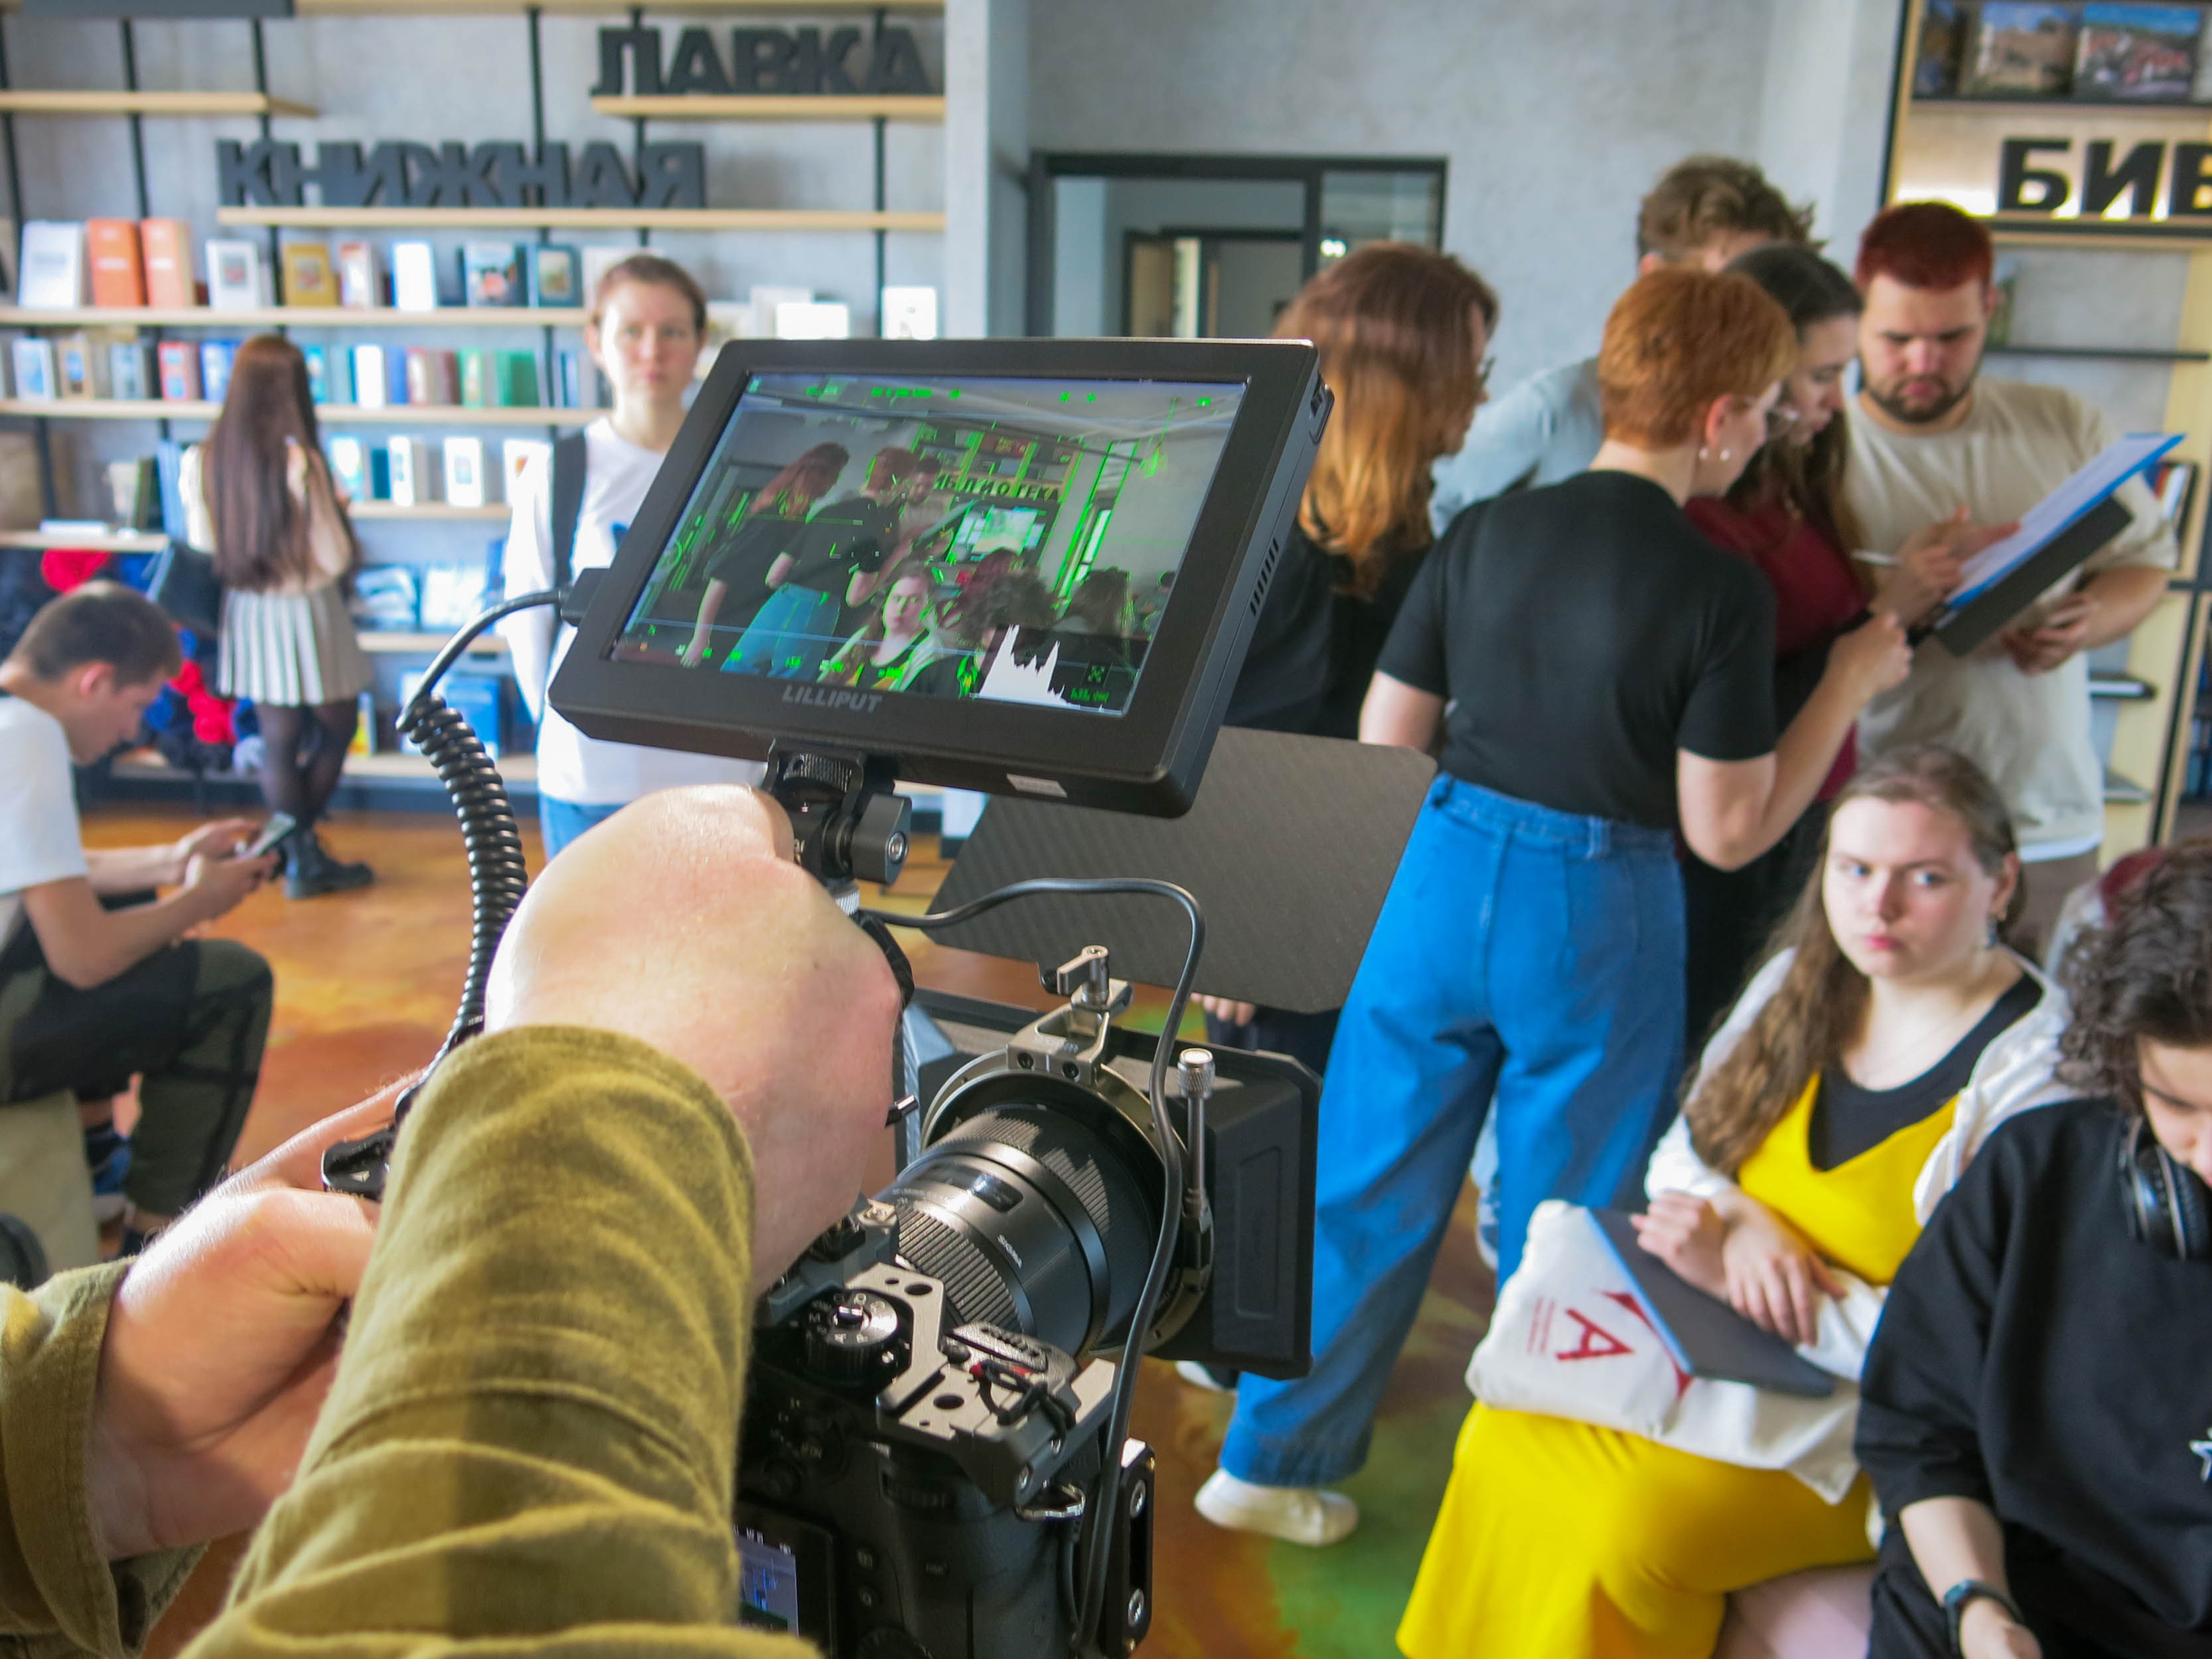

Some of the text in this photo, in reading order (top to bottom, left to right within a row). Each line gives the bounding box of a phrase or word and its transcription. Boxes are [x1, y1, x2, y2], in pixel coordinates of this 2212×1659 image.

[591, 26, 932, 97] ЛАВКА
[216, 139, 706, 208] КНИЖНАЯ
[781, 684, 883, 713] LILLIPUT
